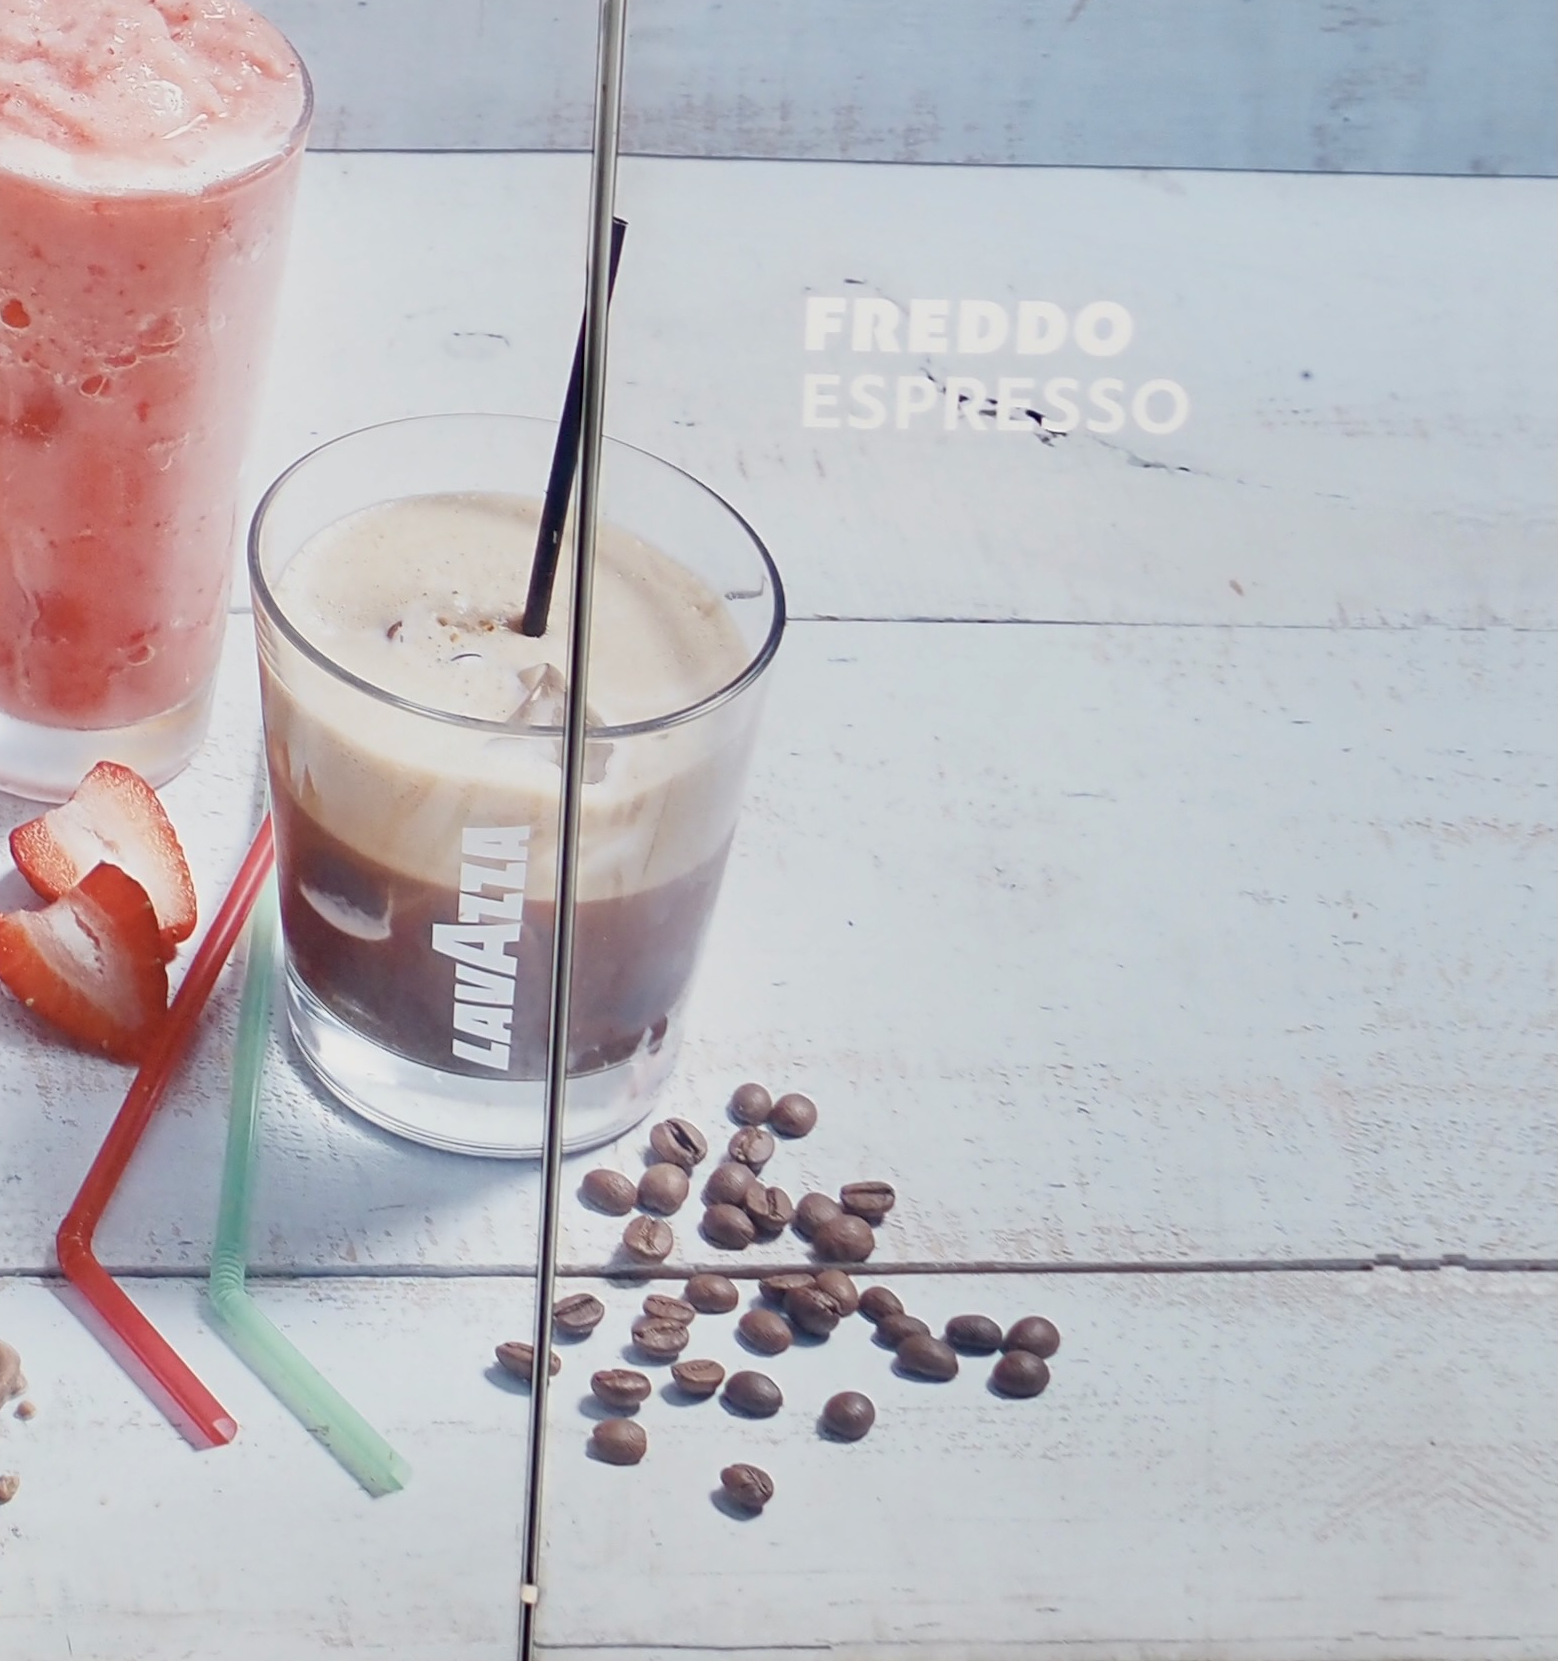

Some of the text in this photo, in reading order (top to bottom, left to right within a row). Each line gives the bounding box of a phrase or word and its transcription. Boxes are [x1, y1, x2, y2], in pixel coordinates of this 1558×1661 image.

[804, 296, 1134, 356] FREDDO
[801, 373, 1191, 436] ESPRESSO
[431, 825, 531, 1072] LAVAZZA
